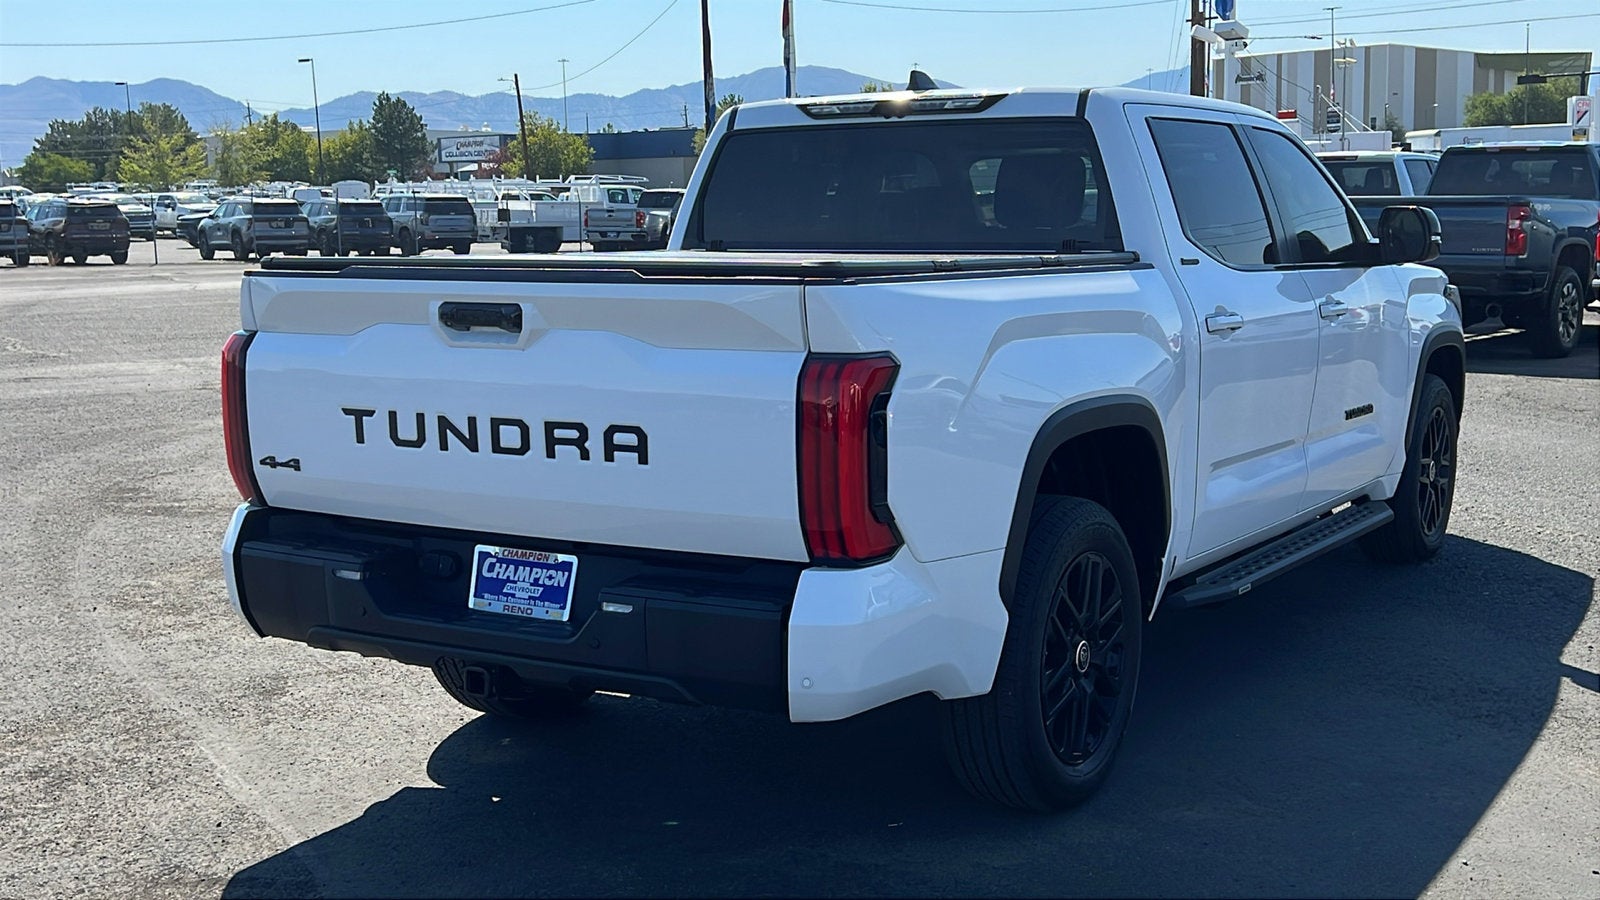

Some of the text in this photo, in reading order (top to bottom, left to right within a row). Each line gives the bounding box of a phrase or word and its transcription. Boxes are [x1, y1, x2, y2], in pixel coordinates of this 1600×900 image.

[474, 149, 497, 157] CENT
[341, 407, 648, 465] TUNDRA
[502, 549, 550, 562] CHAMPION
[482, 557, 569, 587] CHAMPION
[506, 585, 541, 596] CHEVROLET
[503, 605, 533, 615] RENO
